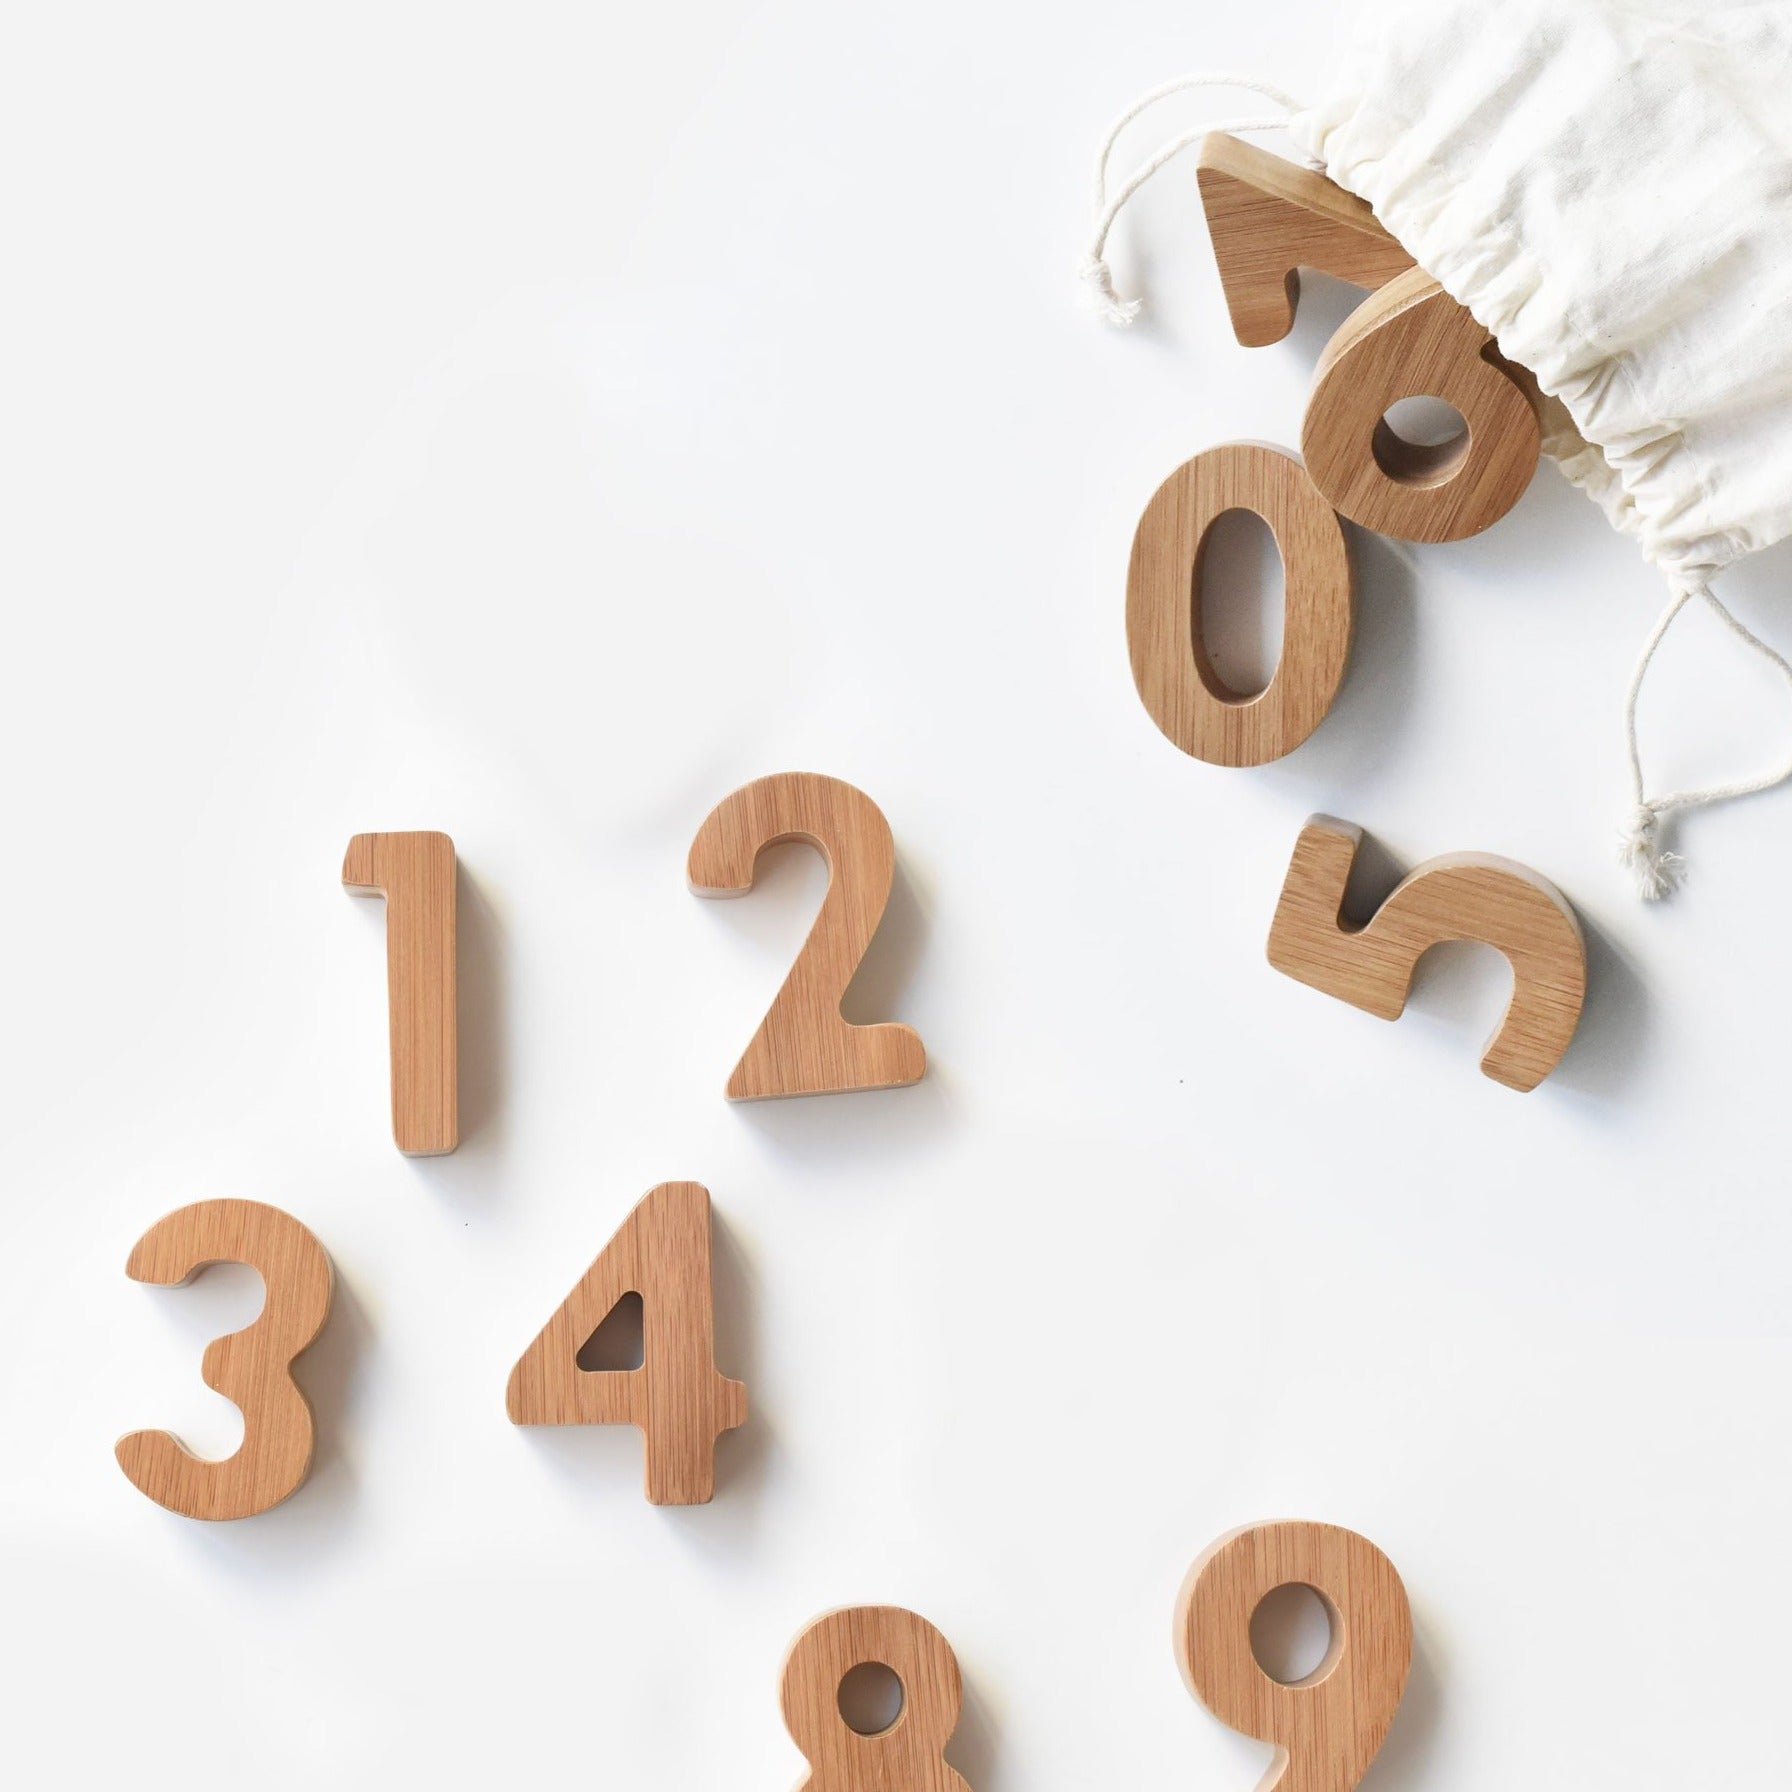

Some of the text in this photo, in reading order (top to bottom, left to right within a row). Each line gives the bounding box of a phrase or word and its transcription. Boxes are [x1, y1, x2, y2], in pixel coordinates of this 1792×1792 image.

[1302, 266, 1542, 543] 6
[1126, 442, 1353, 768] 0
[342, 831, 459, 1157] 1
[687, 771, 928, 1103] 2
[1266, 813, 1587, 1092] 5
[115, 1198, 335, 1521] 3
[506, 1181, 747, 1505] 4
[1174, 1518, 1414, 1792] 9
